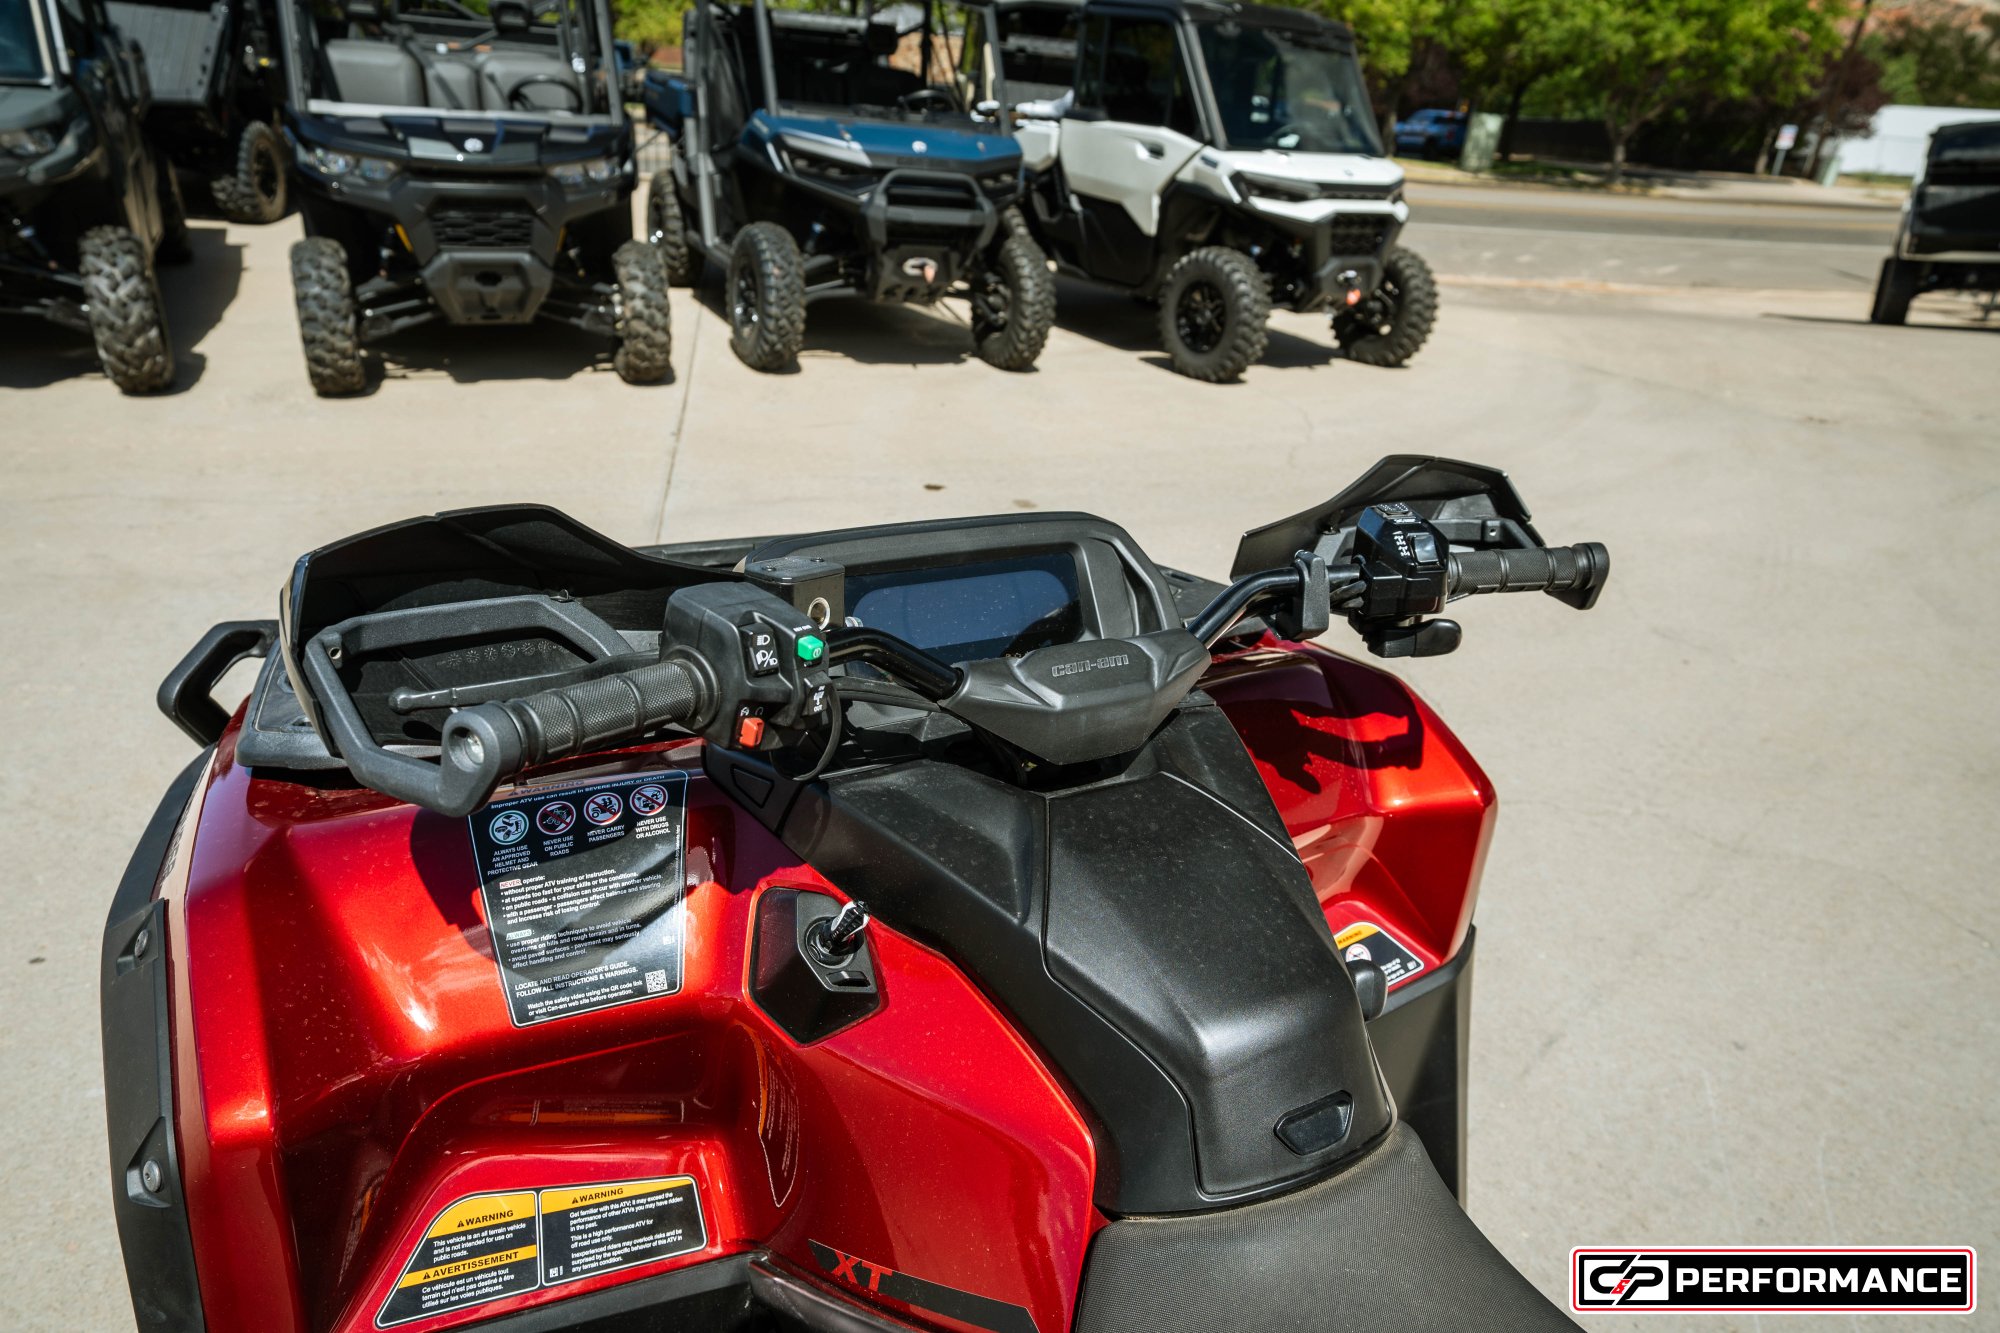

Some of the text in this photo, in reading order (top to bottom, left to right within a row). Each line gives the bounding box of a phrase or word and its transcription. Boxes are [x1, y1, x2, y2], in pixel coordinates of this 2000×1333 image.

[1052, 654, 1129, 677] can-am
[491, 800, 519, 809] Improper
[585, 783, 610, 792] SEVERE
[637, 818, 655, 826] NEVER
[589, 831, 624, 842] PASSENGERS
[645, 828, 670, 837] ALCOHOL
[494, 847, 515, 856] ALWAYS
[501, 851, 530, 860] APPROVED
[488, 865, 521, 875] PROTECTIVE
[504, 887, 524, 896] without
[526, 884, 543, 892] proper
[511, 893, 531, 902] speeds
[563, 884, 575, 892] your
[514, 902, 531, 910] public
[557, 892, 580, 900] collision
[524, 905, 552, 915] passenger
[557, 898, 588, 908] passengers
[519, 913, 542, 922] increase
[515, 981, 538, 990] LOCATE
[516, 988, 541, 998] FOLLOW
[555, 975, 598, 989] INSTRUCTIONS
[547, 1003, 567, 1011] Can-am
[580, 1188, 624, 1202] WARNING
[466, 1210, 514, 1226] WARNING
[433, 1252, 519, 1277] AVERTISSEMENT
[831, 1250, 893, 1292] XT
